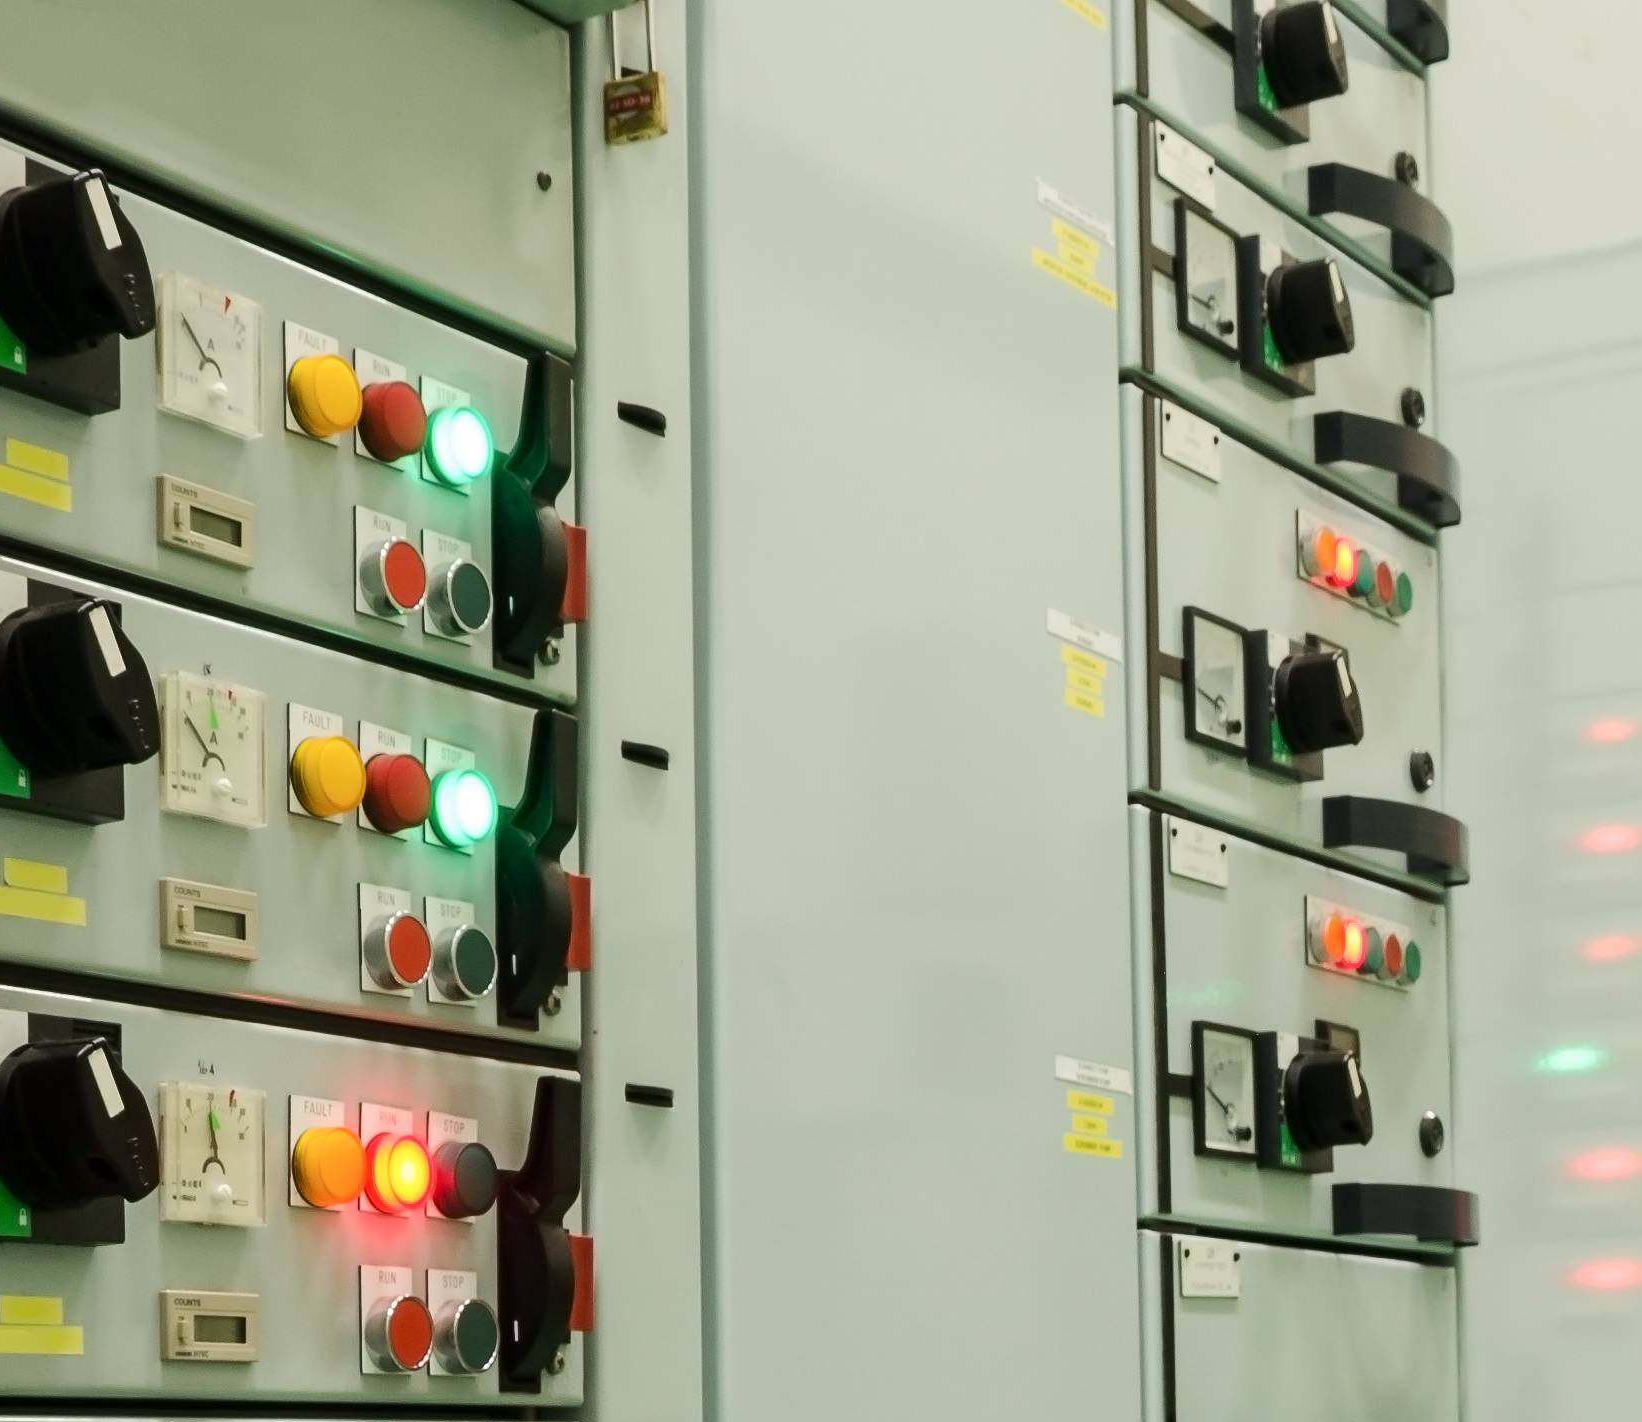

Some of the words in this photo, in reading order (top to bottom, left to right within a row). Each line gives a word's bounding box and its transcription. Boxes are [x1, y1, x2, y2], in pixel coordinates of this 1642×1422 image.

[297, 328, 327, 352] FAULT
[372, 359, 391, 378] RUN
[372, 515, 392, 533] RUN
[302, 713, 332, 731] FAULT
[377, 731, 397, 748] RUN
[441, 747, 463, 762] STOP
[377, 891, 396, 906] RUN
[440, 903, 462, 918] STOP
[302, 1099, 333, 1118] FAULT
[378, 1110, 397, 1127] RUN
[442, 1119, 465, 1134] STOP
[377, 1269, 397, 1284] RUN
[441, 1274, 465, 1289] STOP
